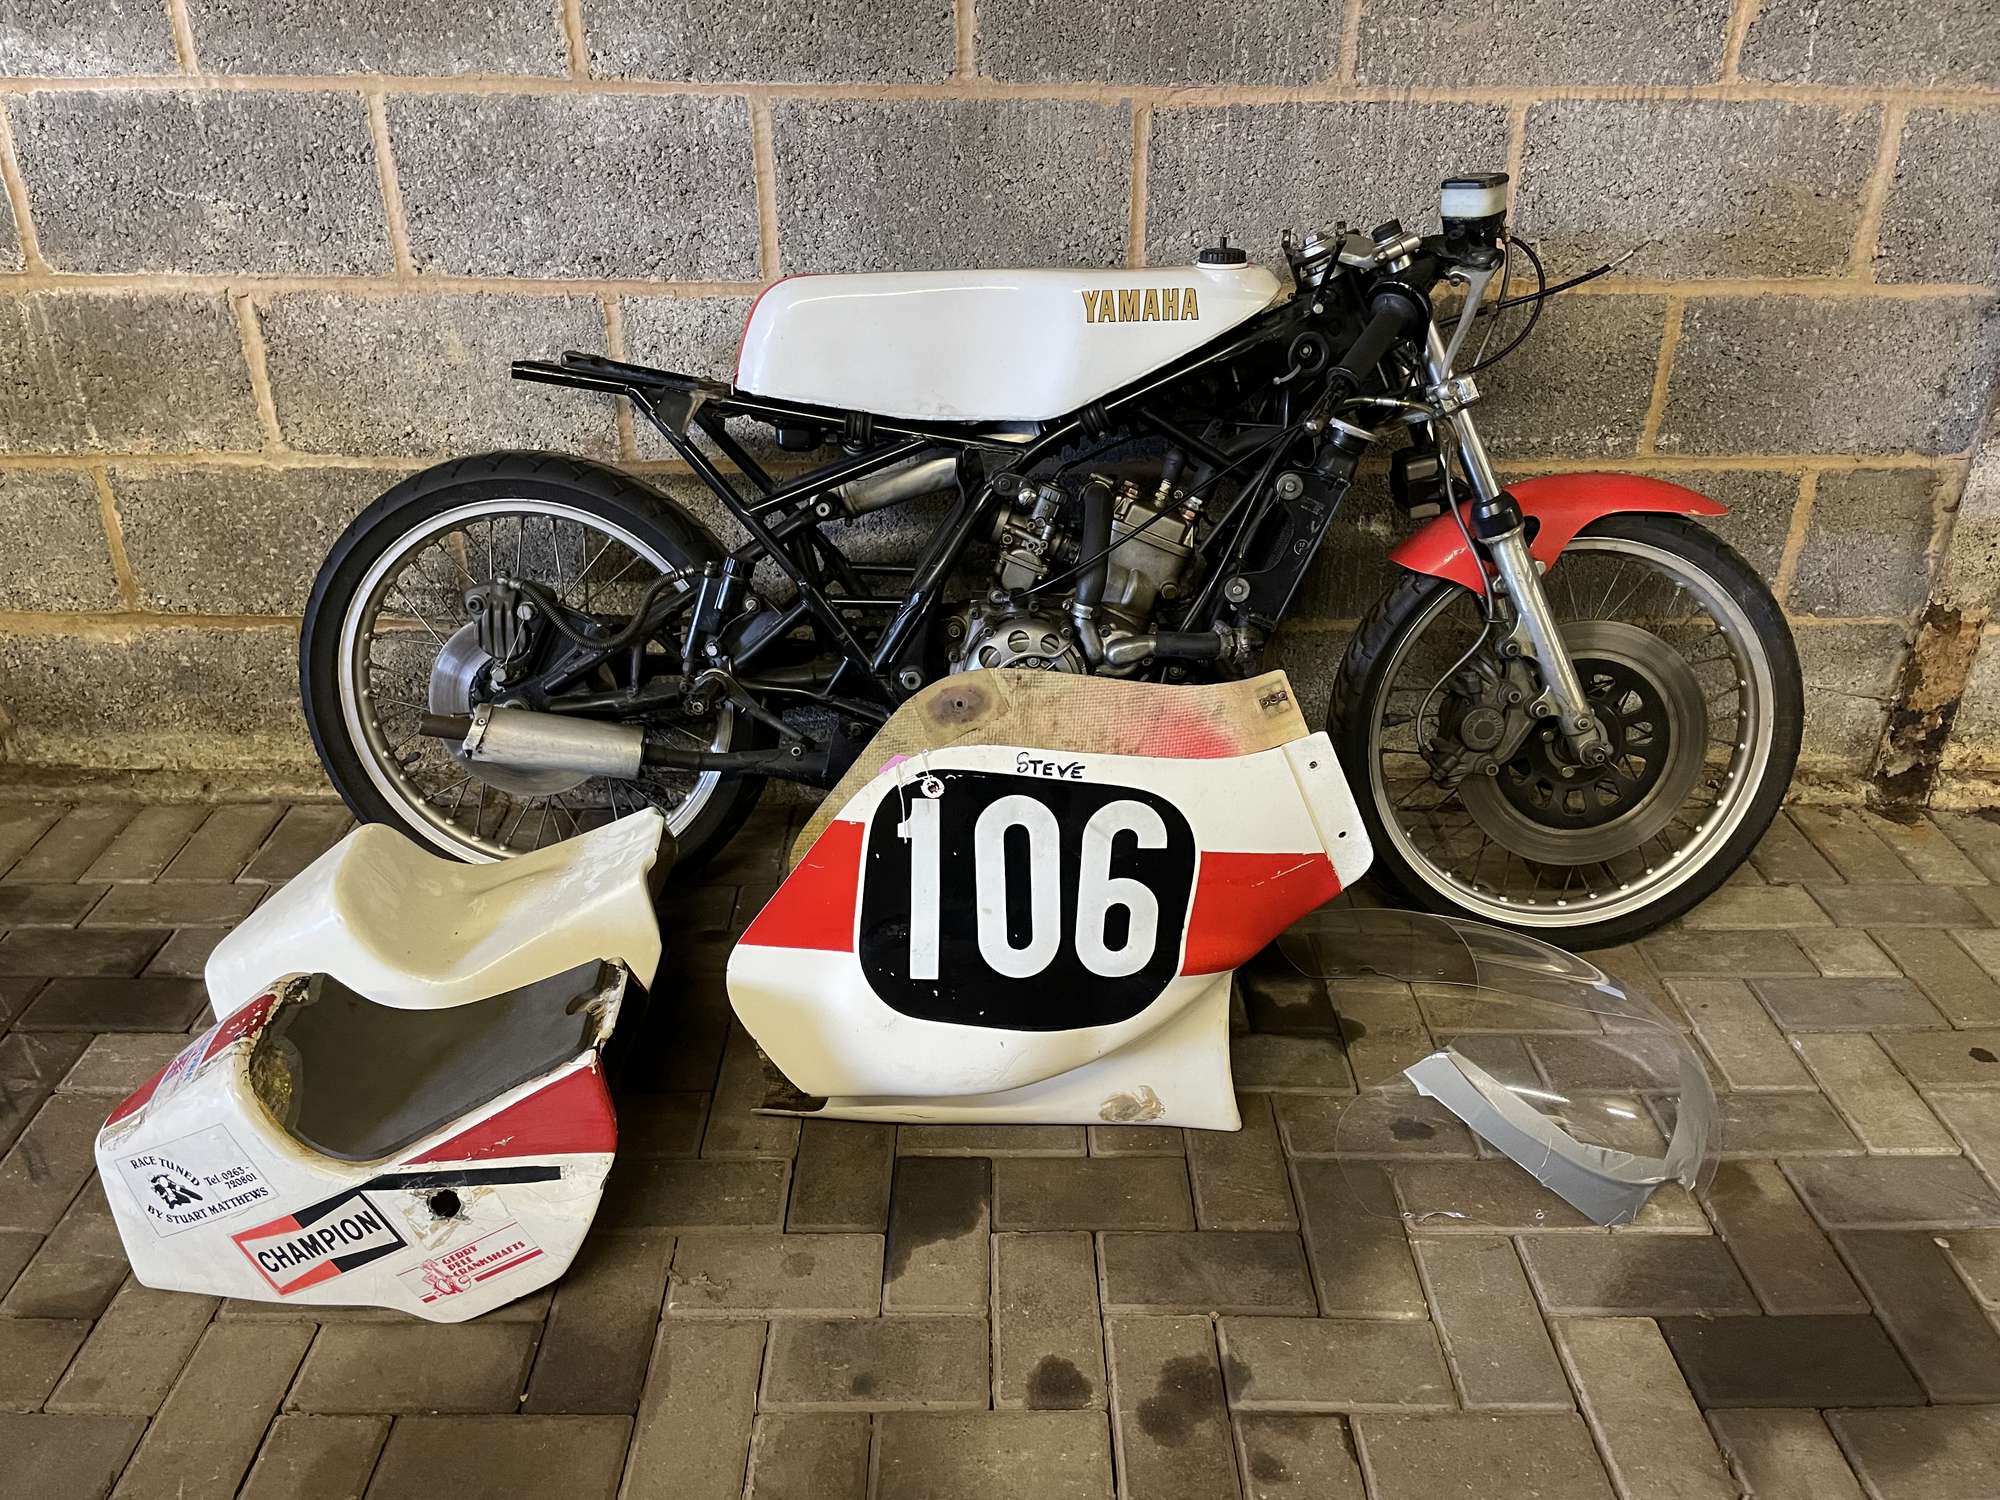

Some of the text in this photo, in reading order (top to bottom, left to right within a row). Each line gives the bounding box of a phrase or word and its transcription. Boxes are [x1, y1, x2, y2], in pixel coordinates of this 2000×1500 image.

[1081, 287, 1199, 323] YAMAHA
[1016, 751, 1086, 779] STEVE
[897, 794, 1168, 980] 106
[130, 1155, 200, 1187] RACE TUNED
[225, 1172, 257, 1190] 720801
[148, 1186, 269, 1224] BY STUART MATTHEWS
[257, 1210, 382, 1273] CHAMPION
[453, 1240, 526, 1277] CRANKSHAFTS
